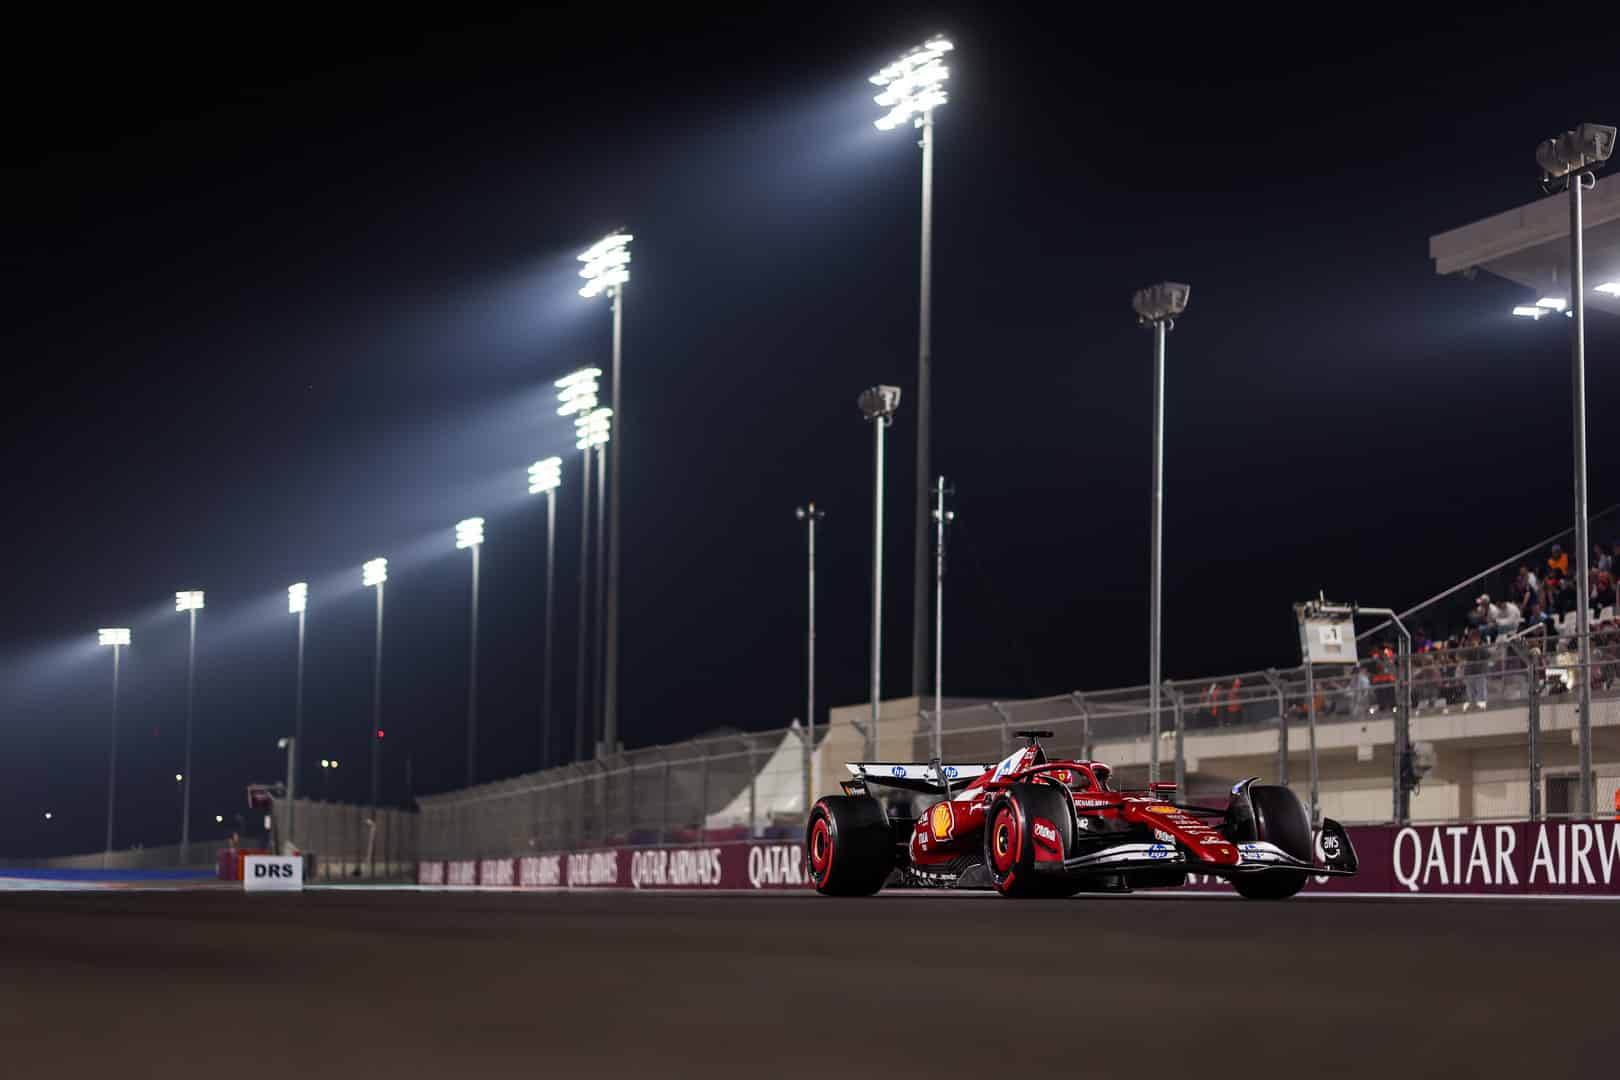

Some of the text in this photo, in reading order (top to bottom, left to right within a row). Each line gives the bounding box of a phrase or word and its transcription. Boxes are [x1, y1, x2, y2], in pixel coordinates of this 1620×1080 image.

[892, 766, 906, 778] hp
[943, 766, 958, 778] hp
[1323, 836, 1339, 849] aws
[1149, 843, 1167, 858] hp
[1393, 826, 1519, 891] QATAR
[255, 863, 293, 878] DRS
[631, 849, 667, 888] QATAR
[748, 845, 801, 888] QATAR
